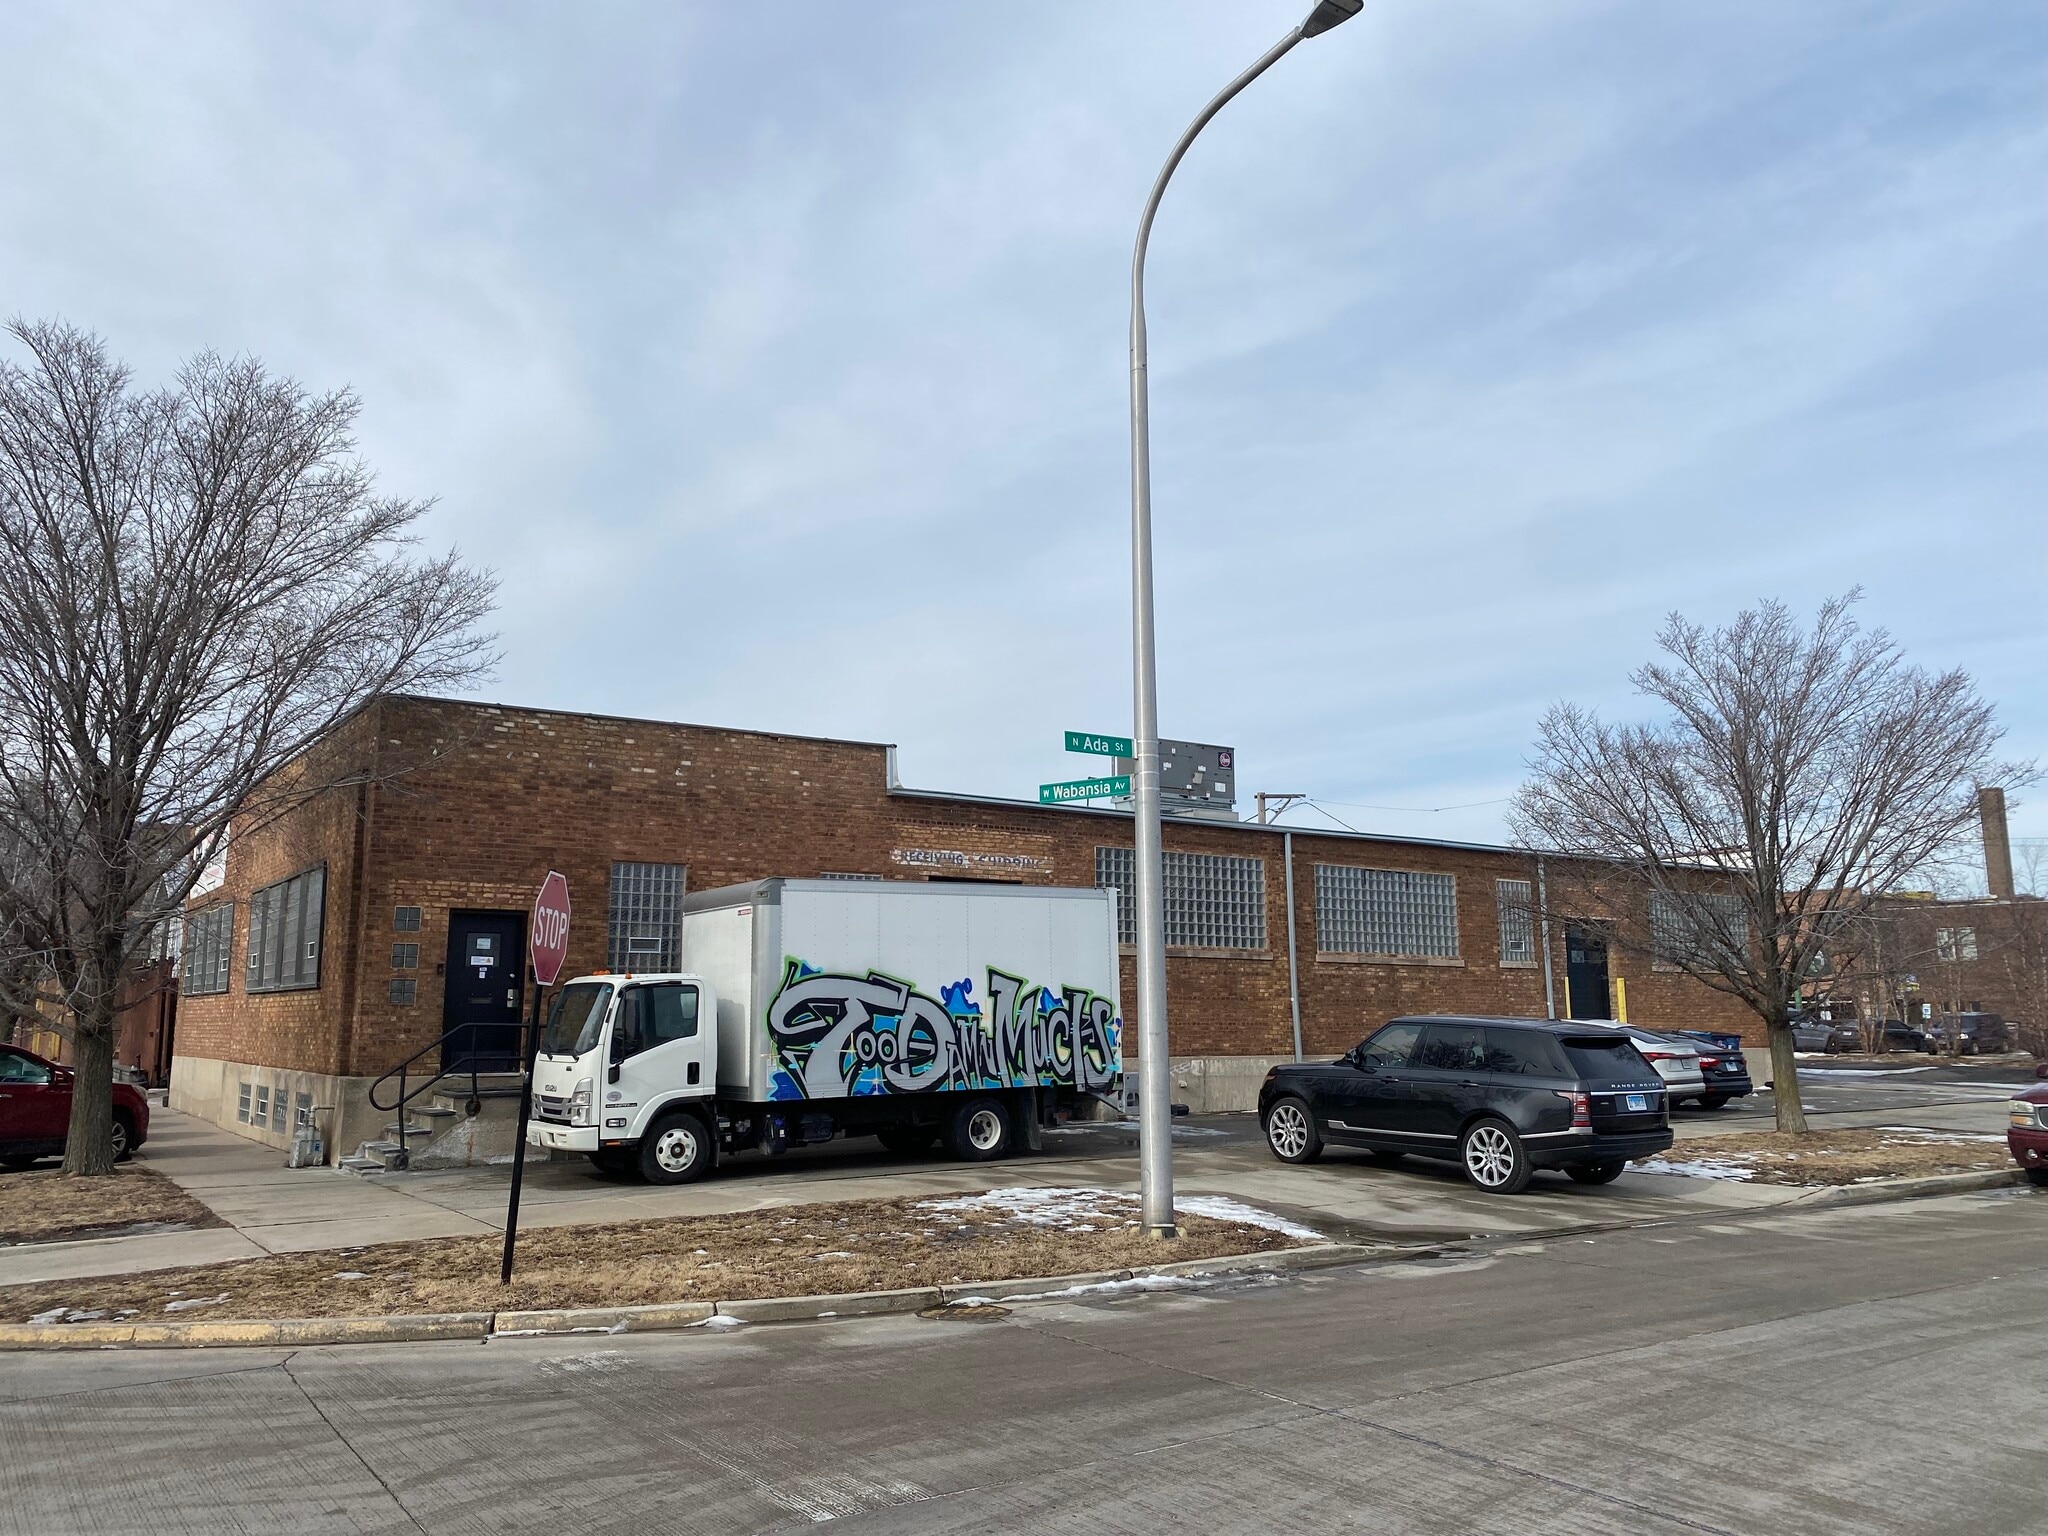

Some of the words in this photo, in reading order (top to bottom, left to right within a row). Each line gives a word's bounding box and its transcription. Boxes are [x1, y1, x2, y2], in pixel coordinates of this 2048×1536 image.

[1072, 738, 1079, 746] N
[1083, 736, 1109, 752] Ada
[1115, 743, 1124, 751] St
[1043, 790, 1049, 798] W
[1053, 781, 1111, 799] Wabansia
[1115, 781, 1125, 790] Av
[535, 905, 568, 950] STOP
